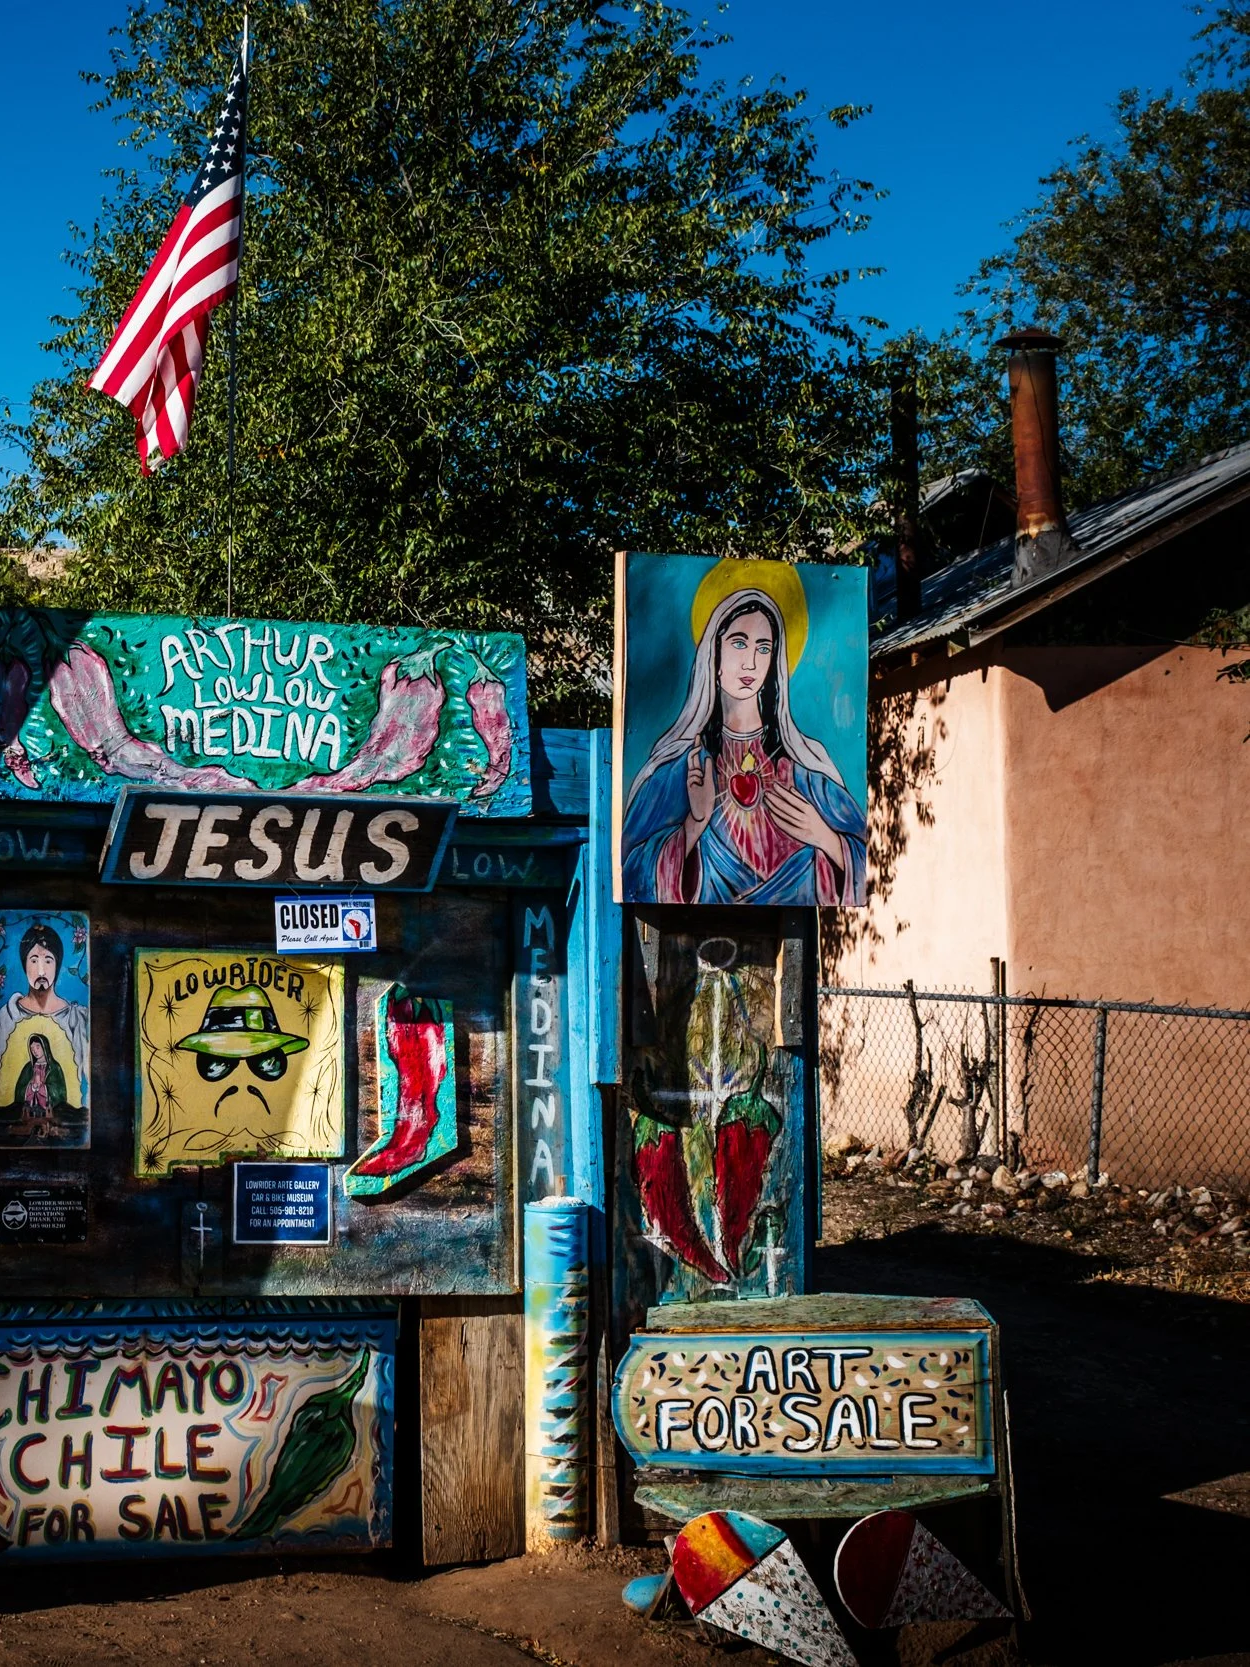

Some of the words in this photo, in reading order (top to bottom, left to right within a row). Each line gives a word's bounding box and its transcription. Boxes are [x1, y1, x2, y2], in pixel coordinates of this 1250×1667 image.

[160, 622, 341, 697] ARTHUR
[161, 705, 344, 771] MEDINA
[129, 803, 422, 886] JESUS
[451, 847, 535, 881] LOW
[280, 904, 339, 930] CLOSED
[281, 935, 302, 943] Please
[304, 934, 318, 944] Call
[320, 934, 339, 944] Again
[173, 957, 305, 1002] LOWRIDER
[523, 905, 556, 1188] MEDINA
[245, 1180, 277, 1190] LOWRIDER
[277, 1180, 293, 1190] ARTE
[293, 1180, 320, 1190] GALLERY
[251, 1193, 264, 1202] CAR
[265, 1193, 270, 1202] &
[271, 1193, 285, 1202] BIKE
[286, 1193, 314, 1202] MUSEUM
[249, 1218, 262, 1227] FOR
[263, 1218, 271, 1227] AN
[273, 1218, 315, 1228] APPOINTMENT
[269, 1206, 314, 1216] 505-901-8210
[735, 1344, 874, 1395] ART
[655, 1395, 761, 1452] FOR
[779, 1392, 942, 1453] SALE
[8, 1420, 233, 1496] CHILE
[17, 1501, 98, 1549] FOR
[116, 1491, 234, 1545] SALE
